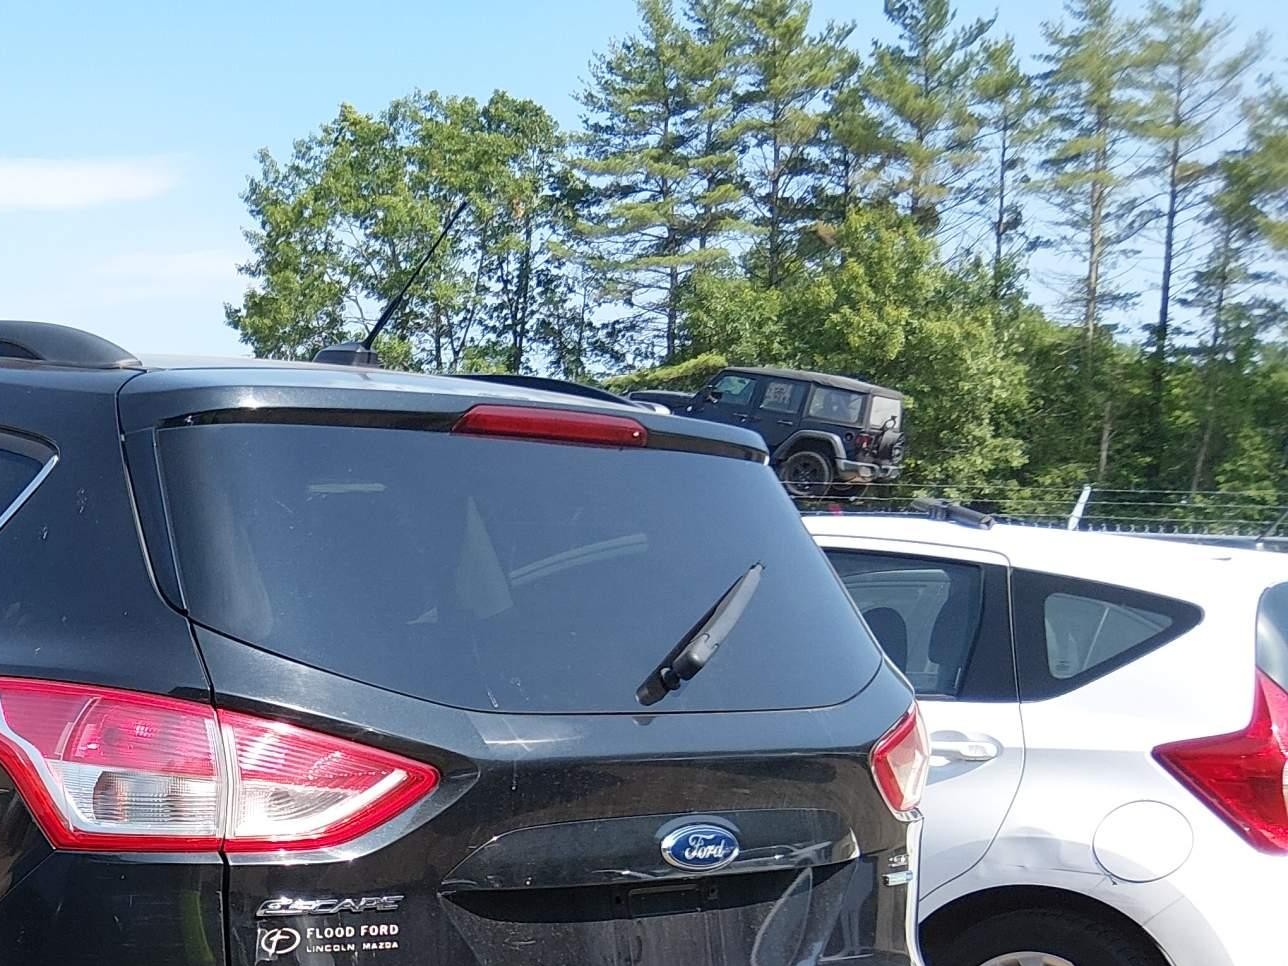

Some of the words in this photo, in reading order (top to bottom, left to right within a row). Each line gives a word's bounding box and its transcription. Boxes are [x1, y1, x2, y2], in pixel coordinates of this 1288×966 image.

[684, 833, 726, 860] Ford
[306, 926, 355, 939] FLOOD
[360, 924, 399, 936] FORD
[306, 943, 355, 953] LINCOLN
[362, 941, 399, 950] MAZDA
